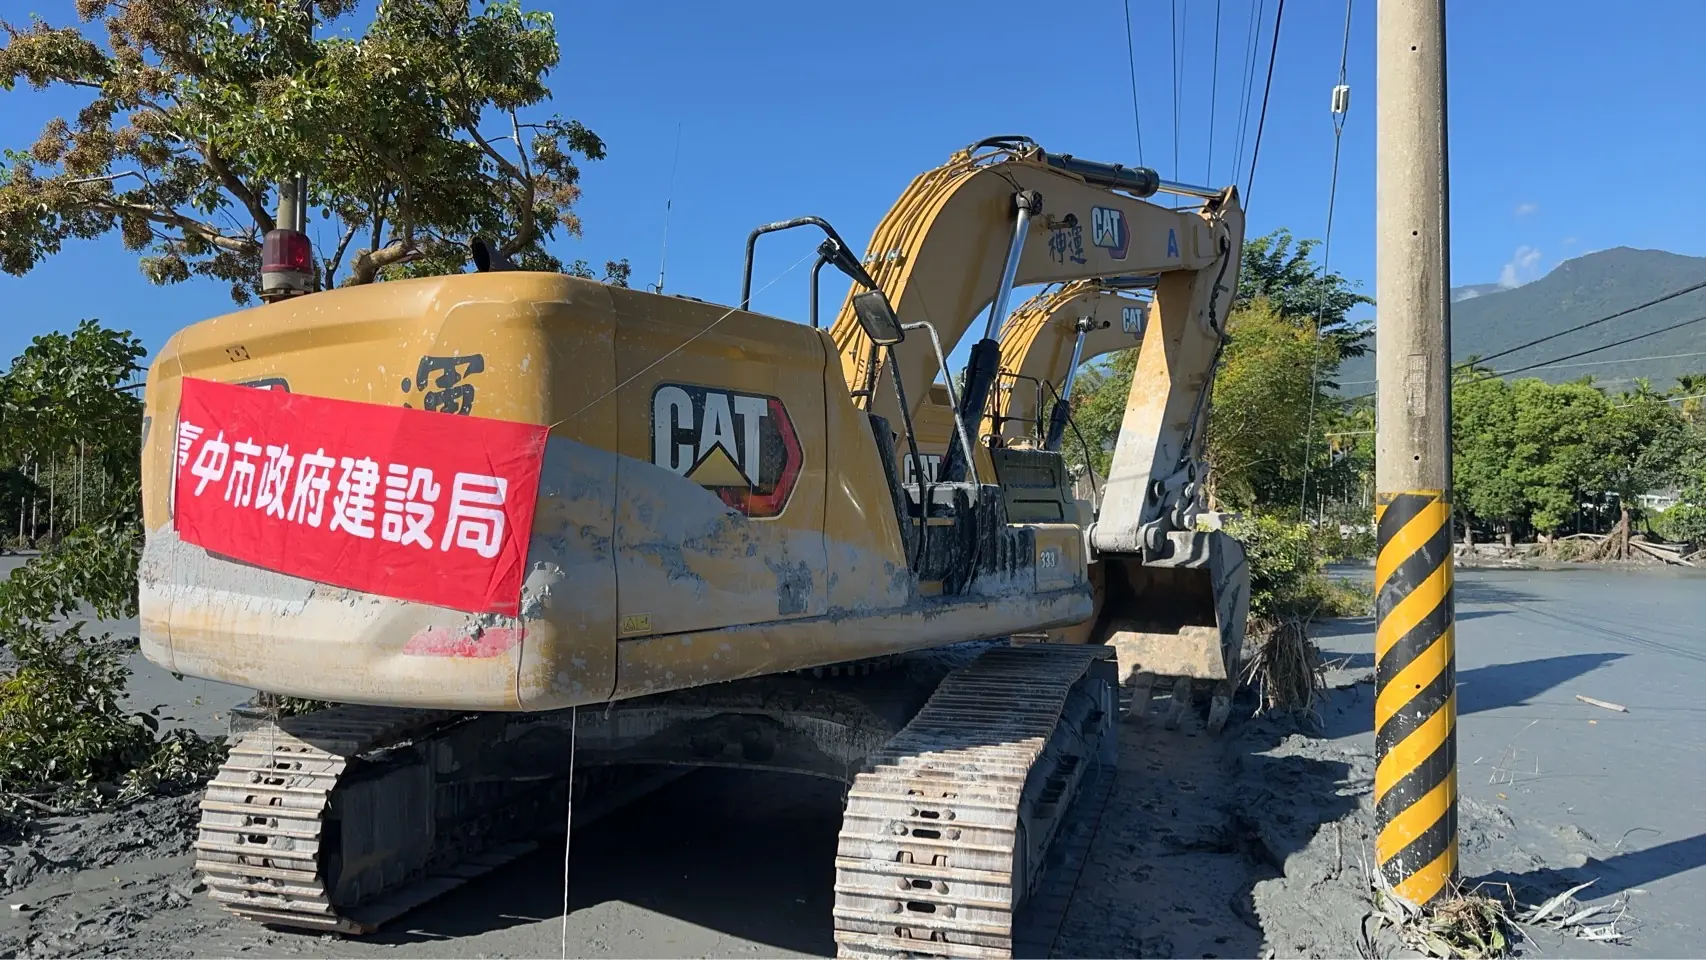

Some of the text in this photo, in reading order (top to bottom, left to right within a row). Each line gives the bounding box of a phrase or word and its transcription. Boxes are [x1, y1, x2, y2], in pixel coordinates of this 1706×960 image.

[1091, 206, 1121, 248] CAT
[1167, 228, 1179, 258] A
[1122, 307, 1143, 333] CAT
[653, 385, 768, 488] CAT
[904, 453, 941, 484] CAT
